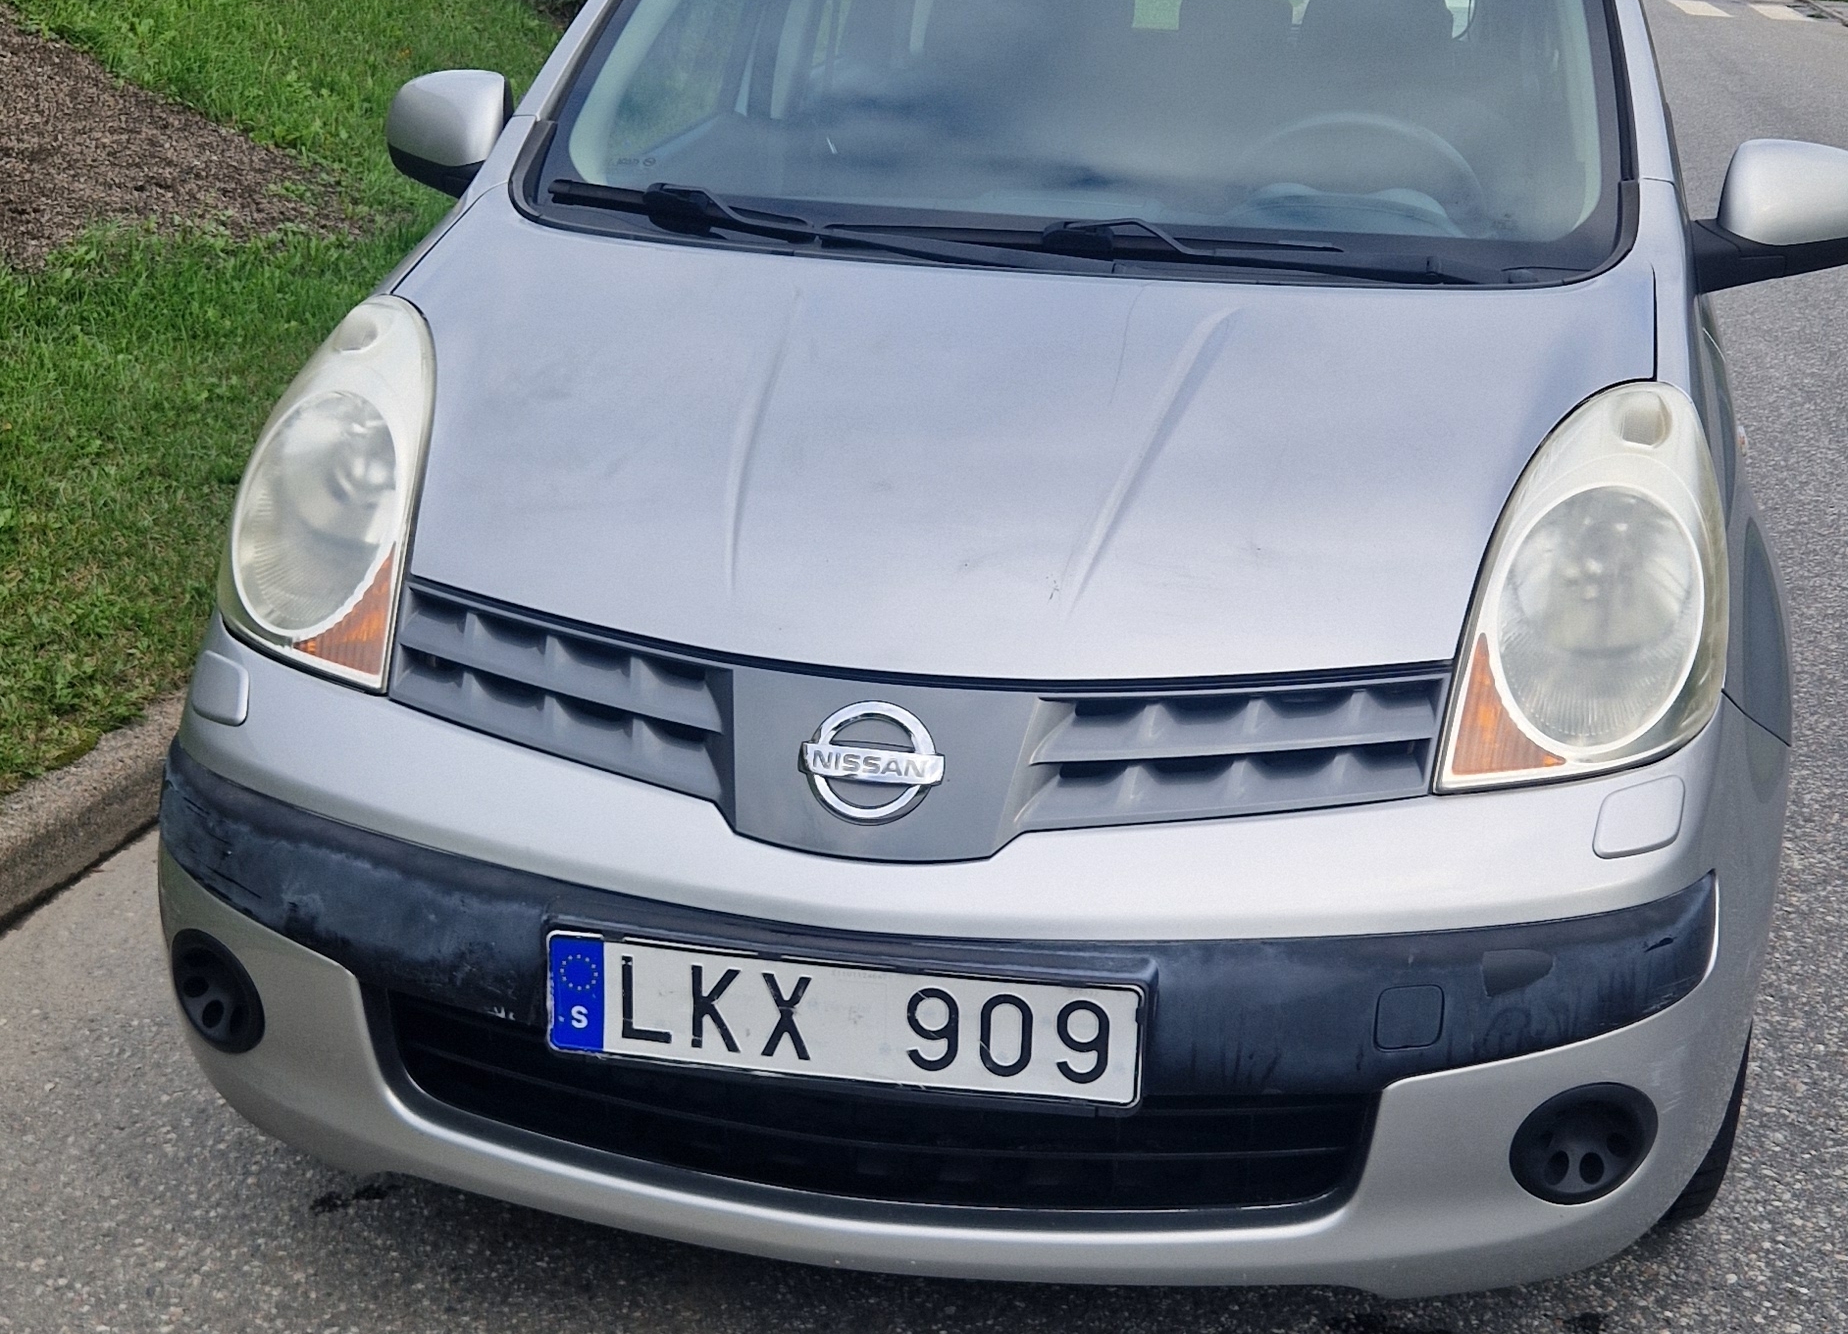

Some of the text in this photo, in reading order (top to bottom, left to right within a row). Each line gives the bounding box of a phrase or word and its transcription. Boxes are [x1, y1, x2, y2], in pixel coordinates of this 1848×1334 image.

[812, 749, 928, 778] NISSAN
[571, 1005, 589, 1029] S
[621, 954, 1110, 1084] LKX 909
